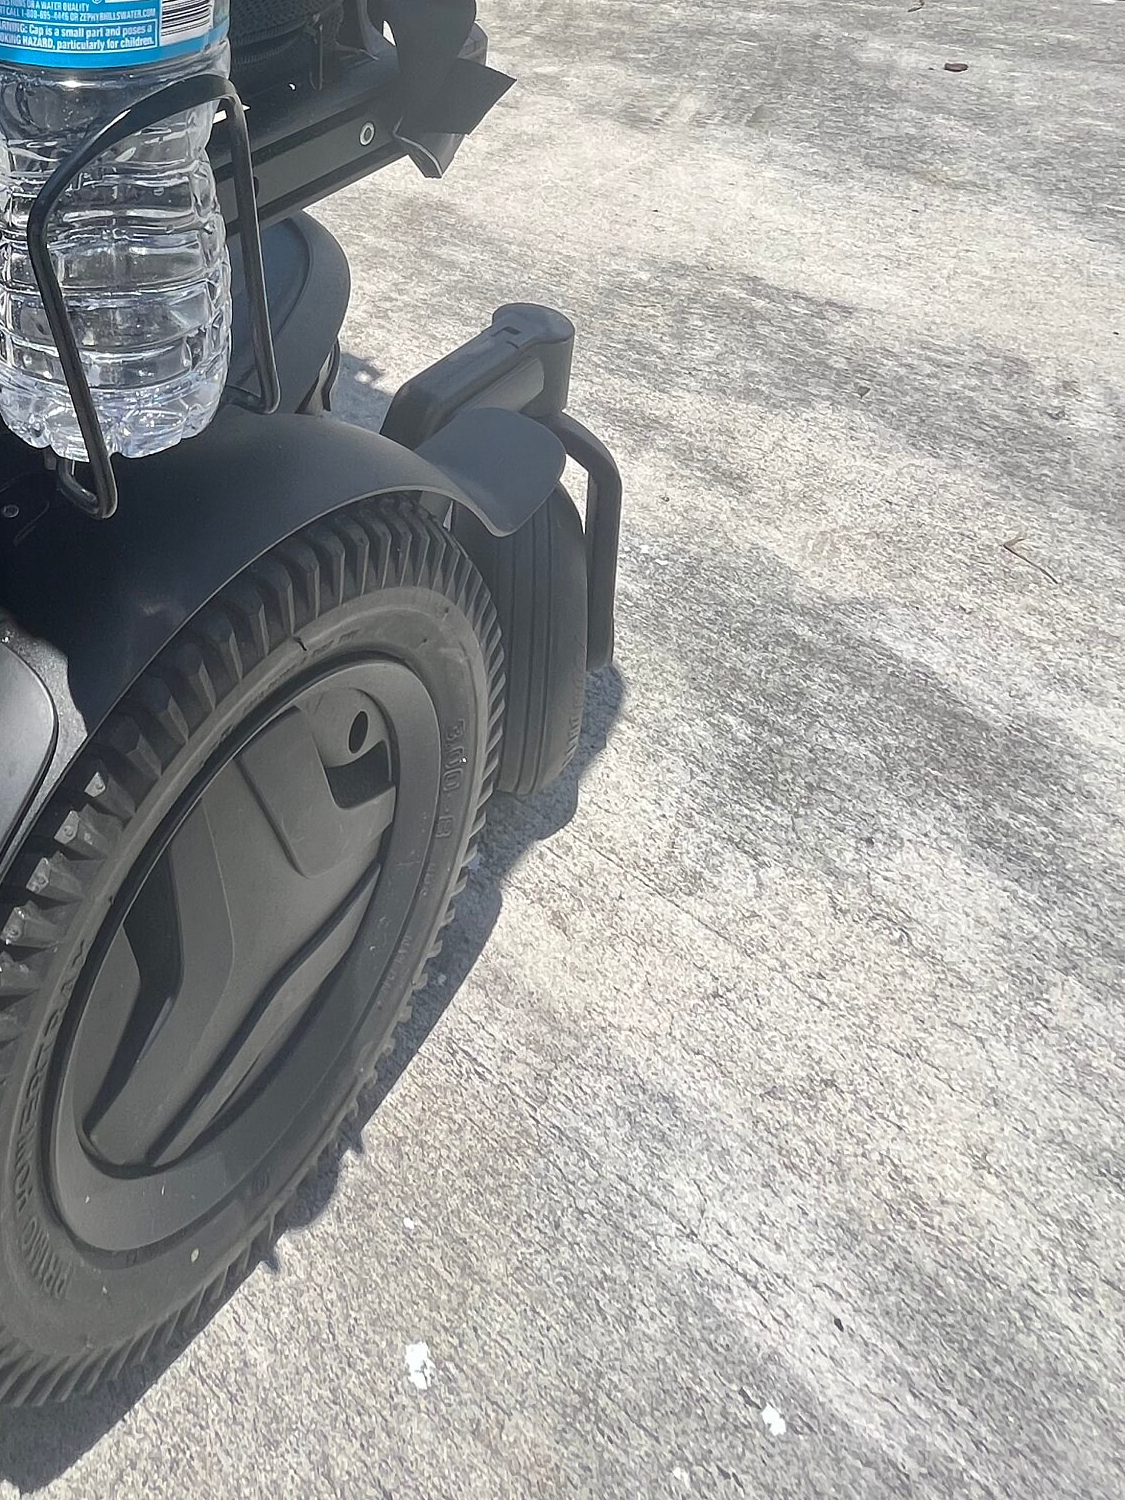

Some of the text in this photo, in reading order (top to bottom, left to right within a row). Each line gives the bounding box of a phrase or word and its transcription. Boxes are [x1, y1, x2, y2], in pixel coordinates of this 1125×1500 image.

[6, 6, 20, 16] CALL
[29, 24, 44, 36] Cap
[45, 26, 53, 36] is
[54, 28, 60, 36] a
[61, 28, 84, 38] small
[86, 28, 104, 39] part
[105, 26, 121, 37] and
[122, 25, 146, 38] poses
[147, 24, 153, 33] a
[22, 36, 56, 50] HAZARD,
[56, 40, 106, 52] particularly
[106, 38, 118, 49] for
[120, 36, 154, 48] children.
